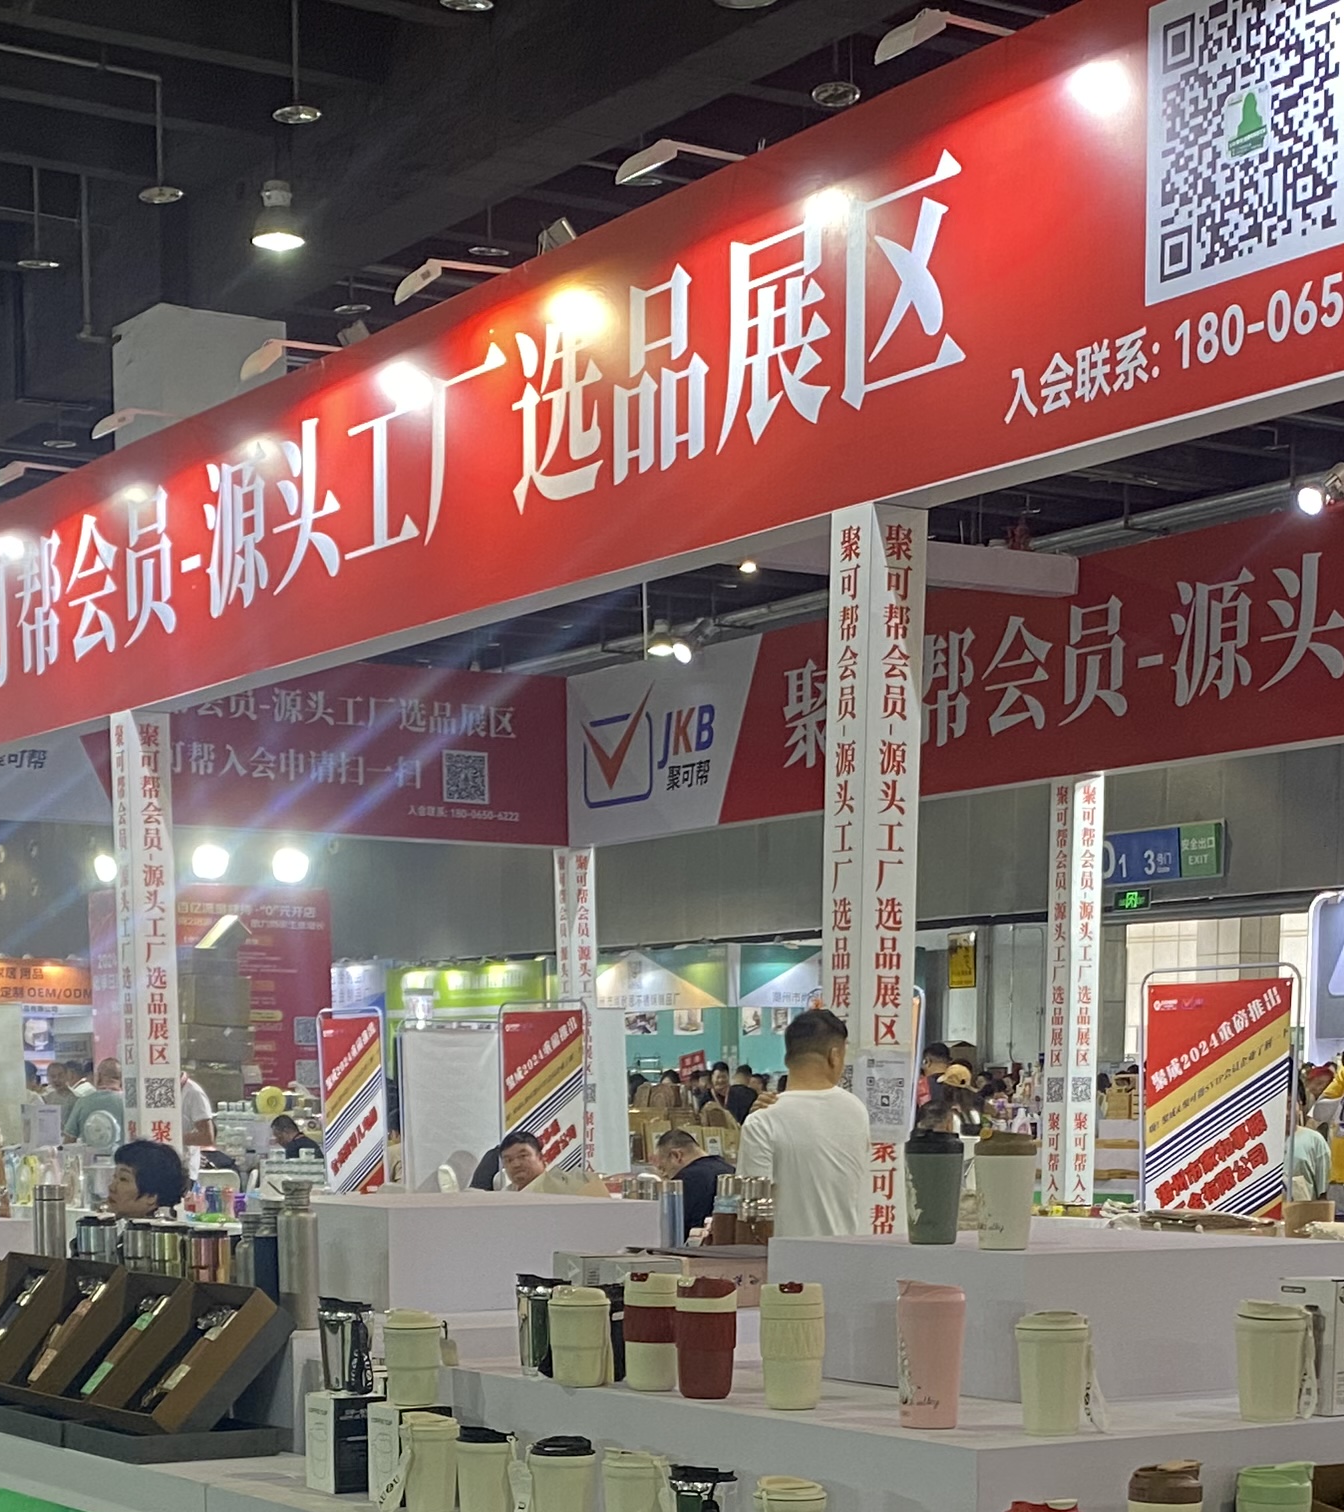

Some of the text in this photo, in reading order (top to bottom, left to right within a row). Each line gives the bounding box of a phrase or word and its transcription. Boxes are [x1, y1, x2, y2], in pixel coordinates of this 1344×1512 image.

[1004, 327, 1161, 425] 入会联系:
[657, 703, 716, 770] JKB
[666, 759, 711, 791] 聚可帮
[831, 524, 861, 1044] 聚可帮会员-源头工厂选品展
[873, 523, 913, 1047] 聚可帮会员-源头工厂选品展区
[1181, 837, 1216, 851] 安全出口
[1188, 854, 1209, 866] EXIT
[1150, 986, 1283, 1093] 聚成2024重磅推出
